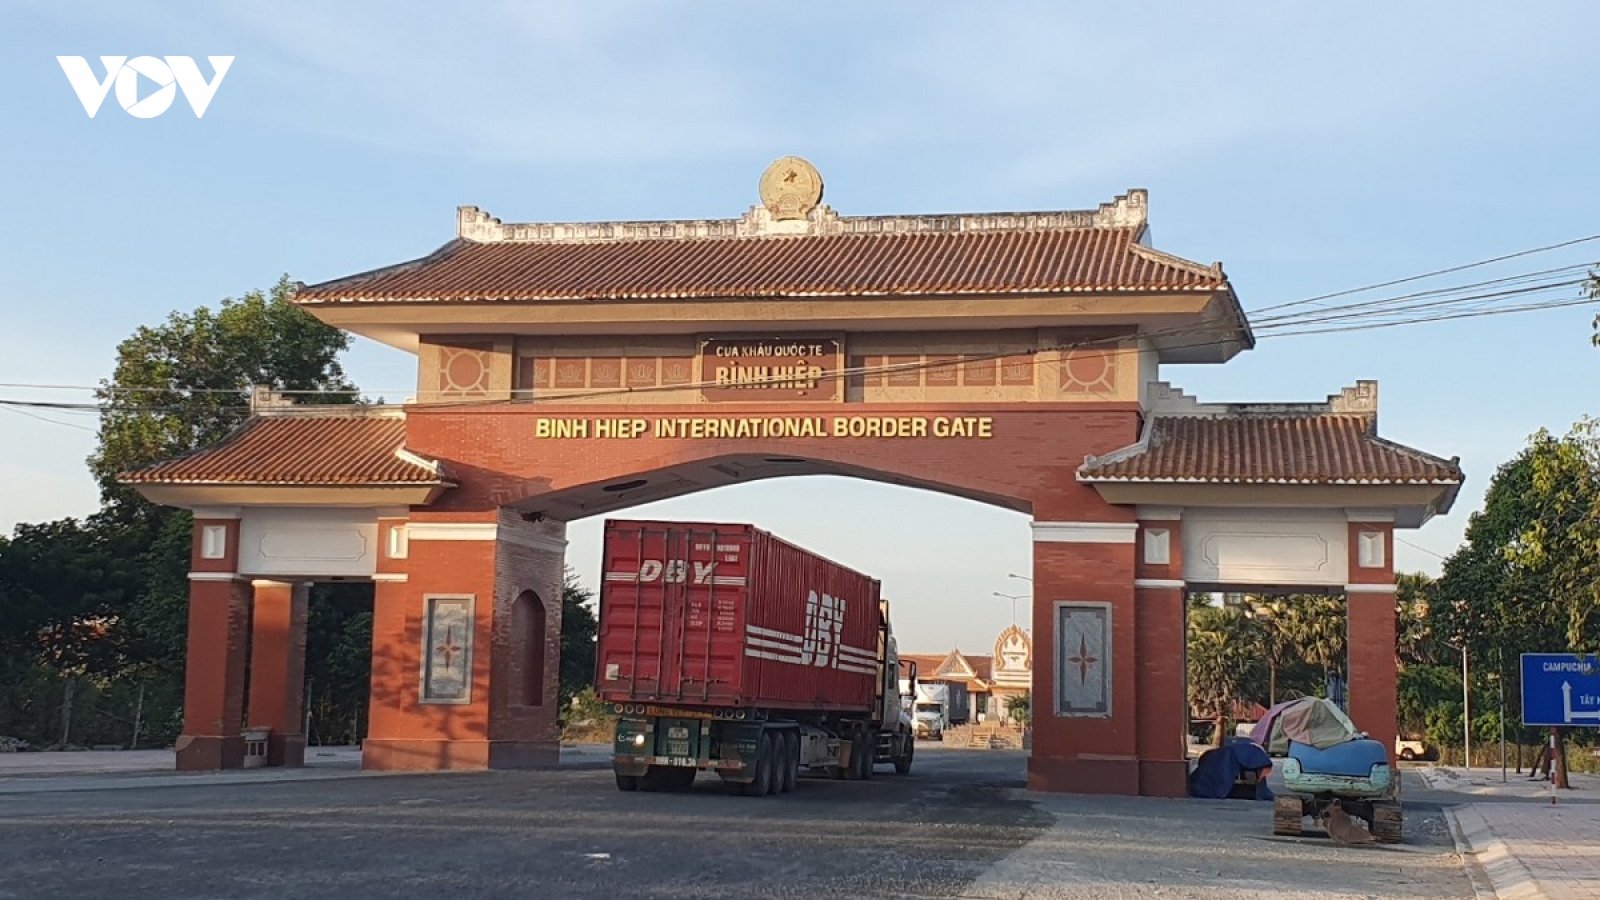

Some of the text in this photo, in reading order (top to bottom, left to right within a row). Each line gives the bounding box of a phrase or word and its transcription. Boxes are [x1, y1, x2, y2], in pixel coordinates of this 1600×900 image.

[535, 415, 993, 439] BINH HIEP INTERNATIONAL BORDER GATE
[1543, 662, 1592, 672] CAMPUCHIA
